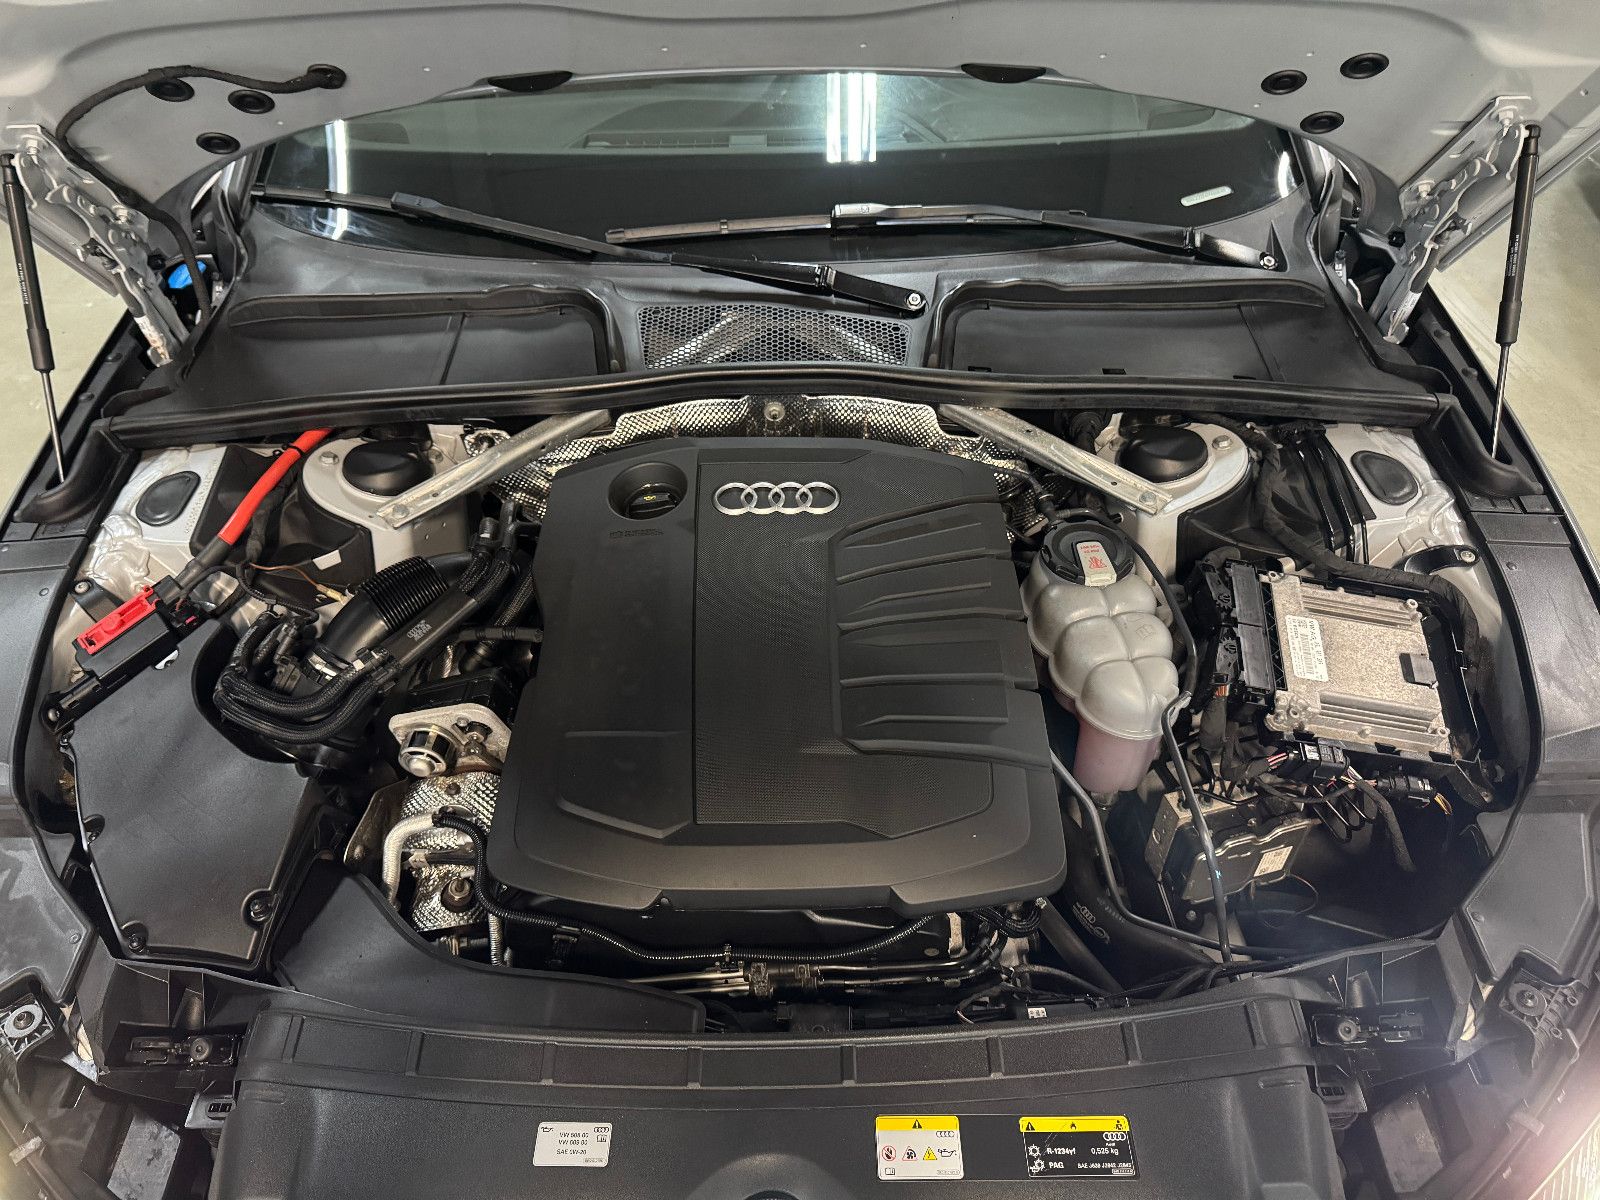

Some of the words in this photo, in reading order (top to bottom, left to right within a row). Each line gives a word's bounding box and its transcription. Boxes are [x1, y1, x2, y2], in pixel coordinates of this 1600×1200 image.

[1091, 1147, 1110, 1155] 0,525
[1110, 1147, 1119, 1156] kg
[1049, 1161, 1065, 1169] PAG
